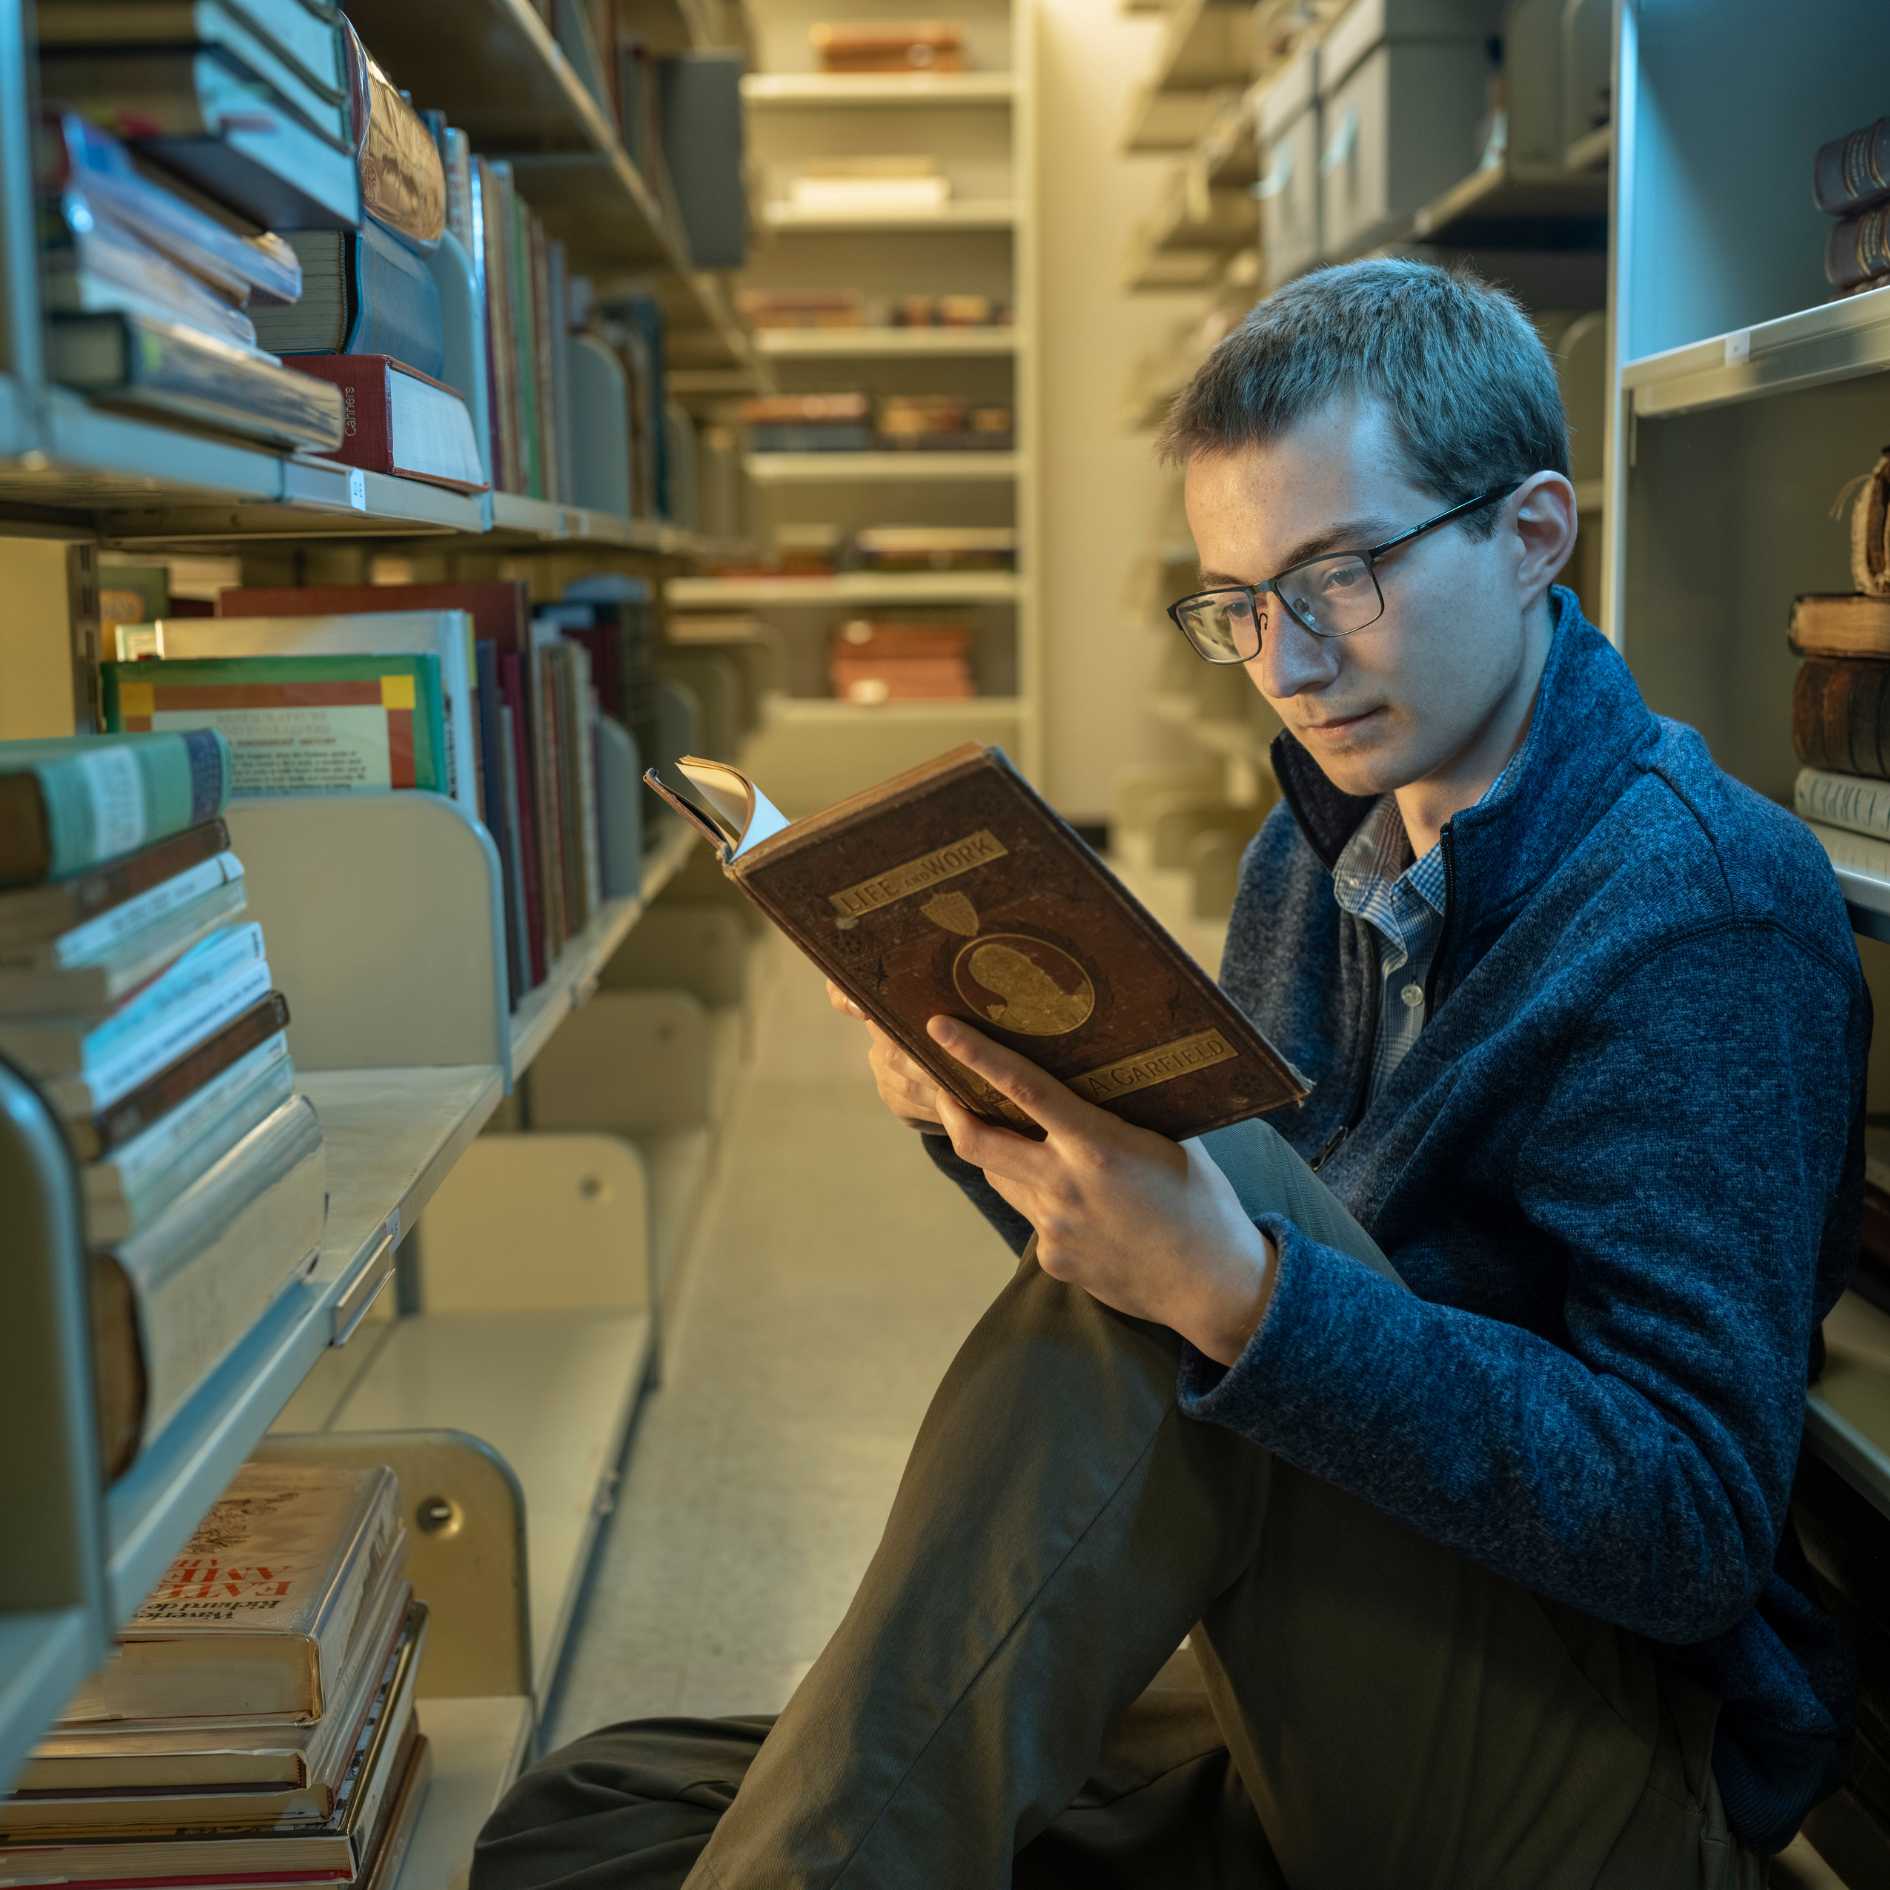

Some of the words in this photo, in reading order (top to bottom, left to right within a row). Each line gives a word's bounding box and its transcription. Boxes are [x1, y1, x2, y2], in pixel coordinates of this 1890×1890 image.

[839, 878, 899, 913] LIFE
[904, 871, 930, 889] AND
[922, 836, 996, 876] WORK
[1111, 1038, 1225, 1086] GARFIELD
[161, 1566, 292, 1583] AME
